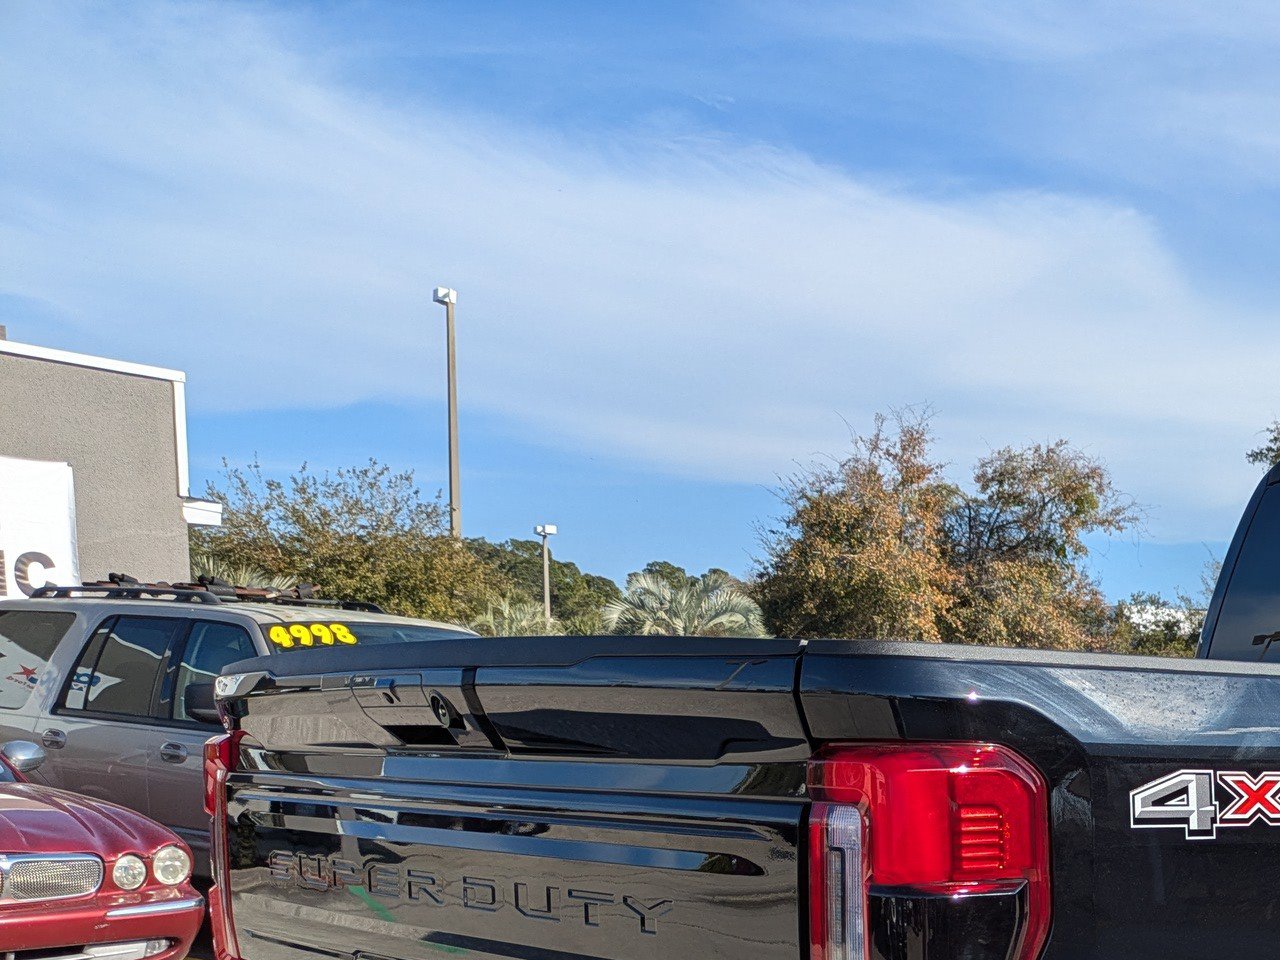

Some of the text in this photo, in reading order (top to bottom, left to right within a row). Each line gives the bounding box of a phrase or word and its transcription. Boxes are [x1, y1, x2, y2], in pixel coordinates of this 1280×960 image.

[269, 623, 357, 648] 4998
[267, 850, 674, 934] SUPER DUTY
